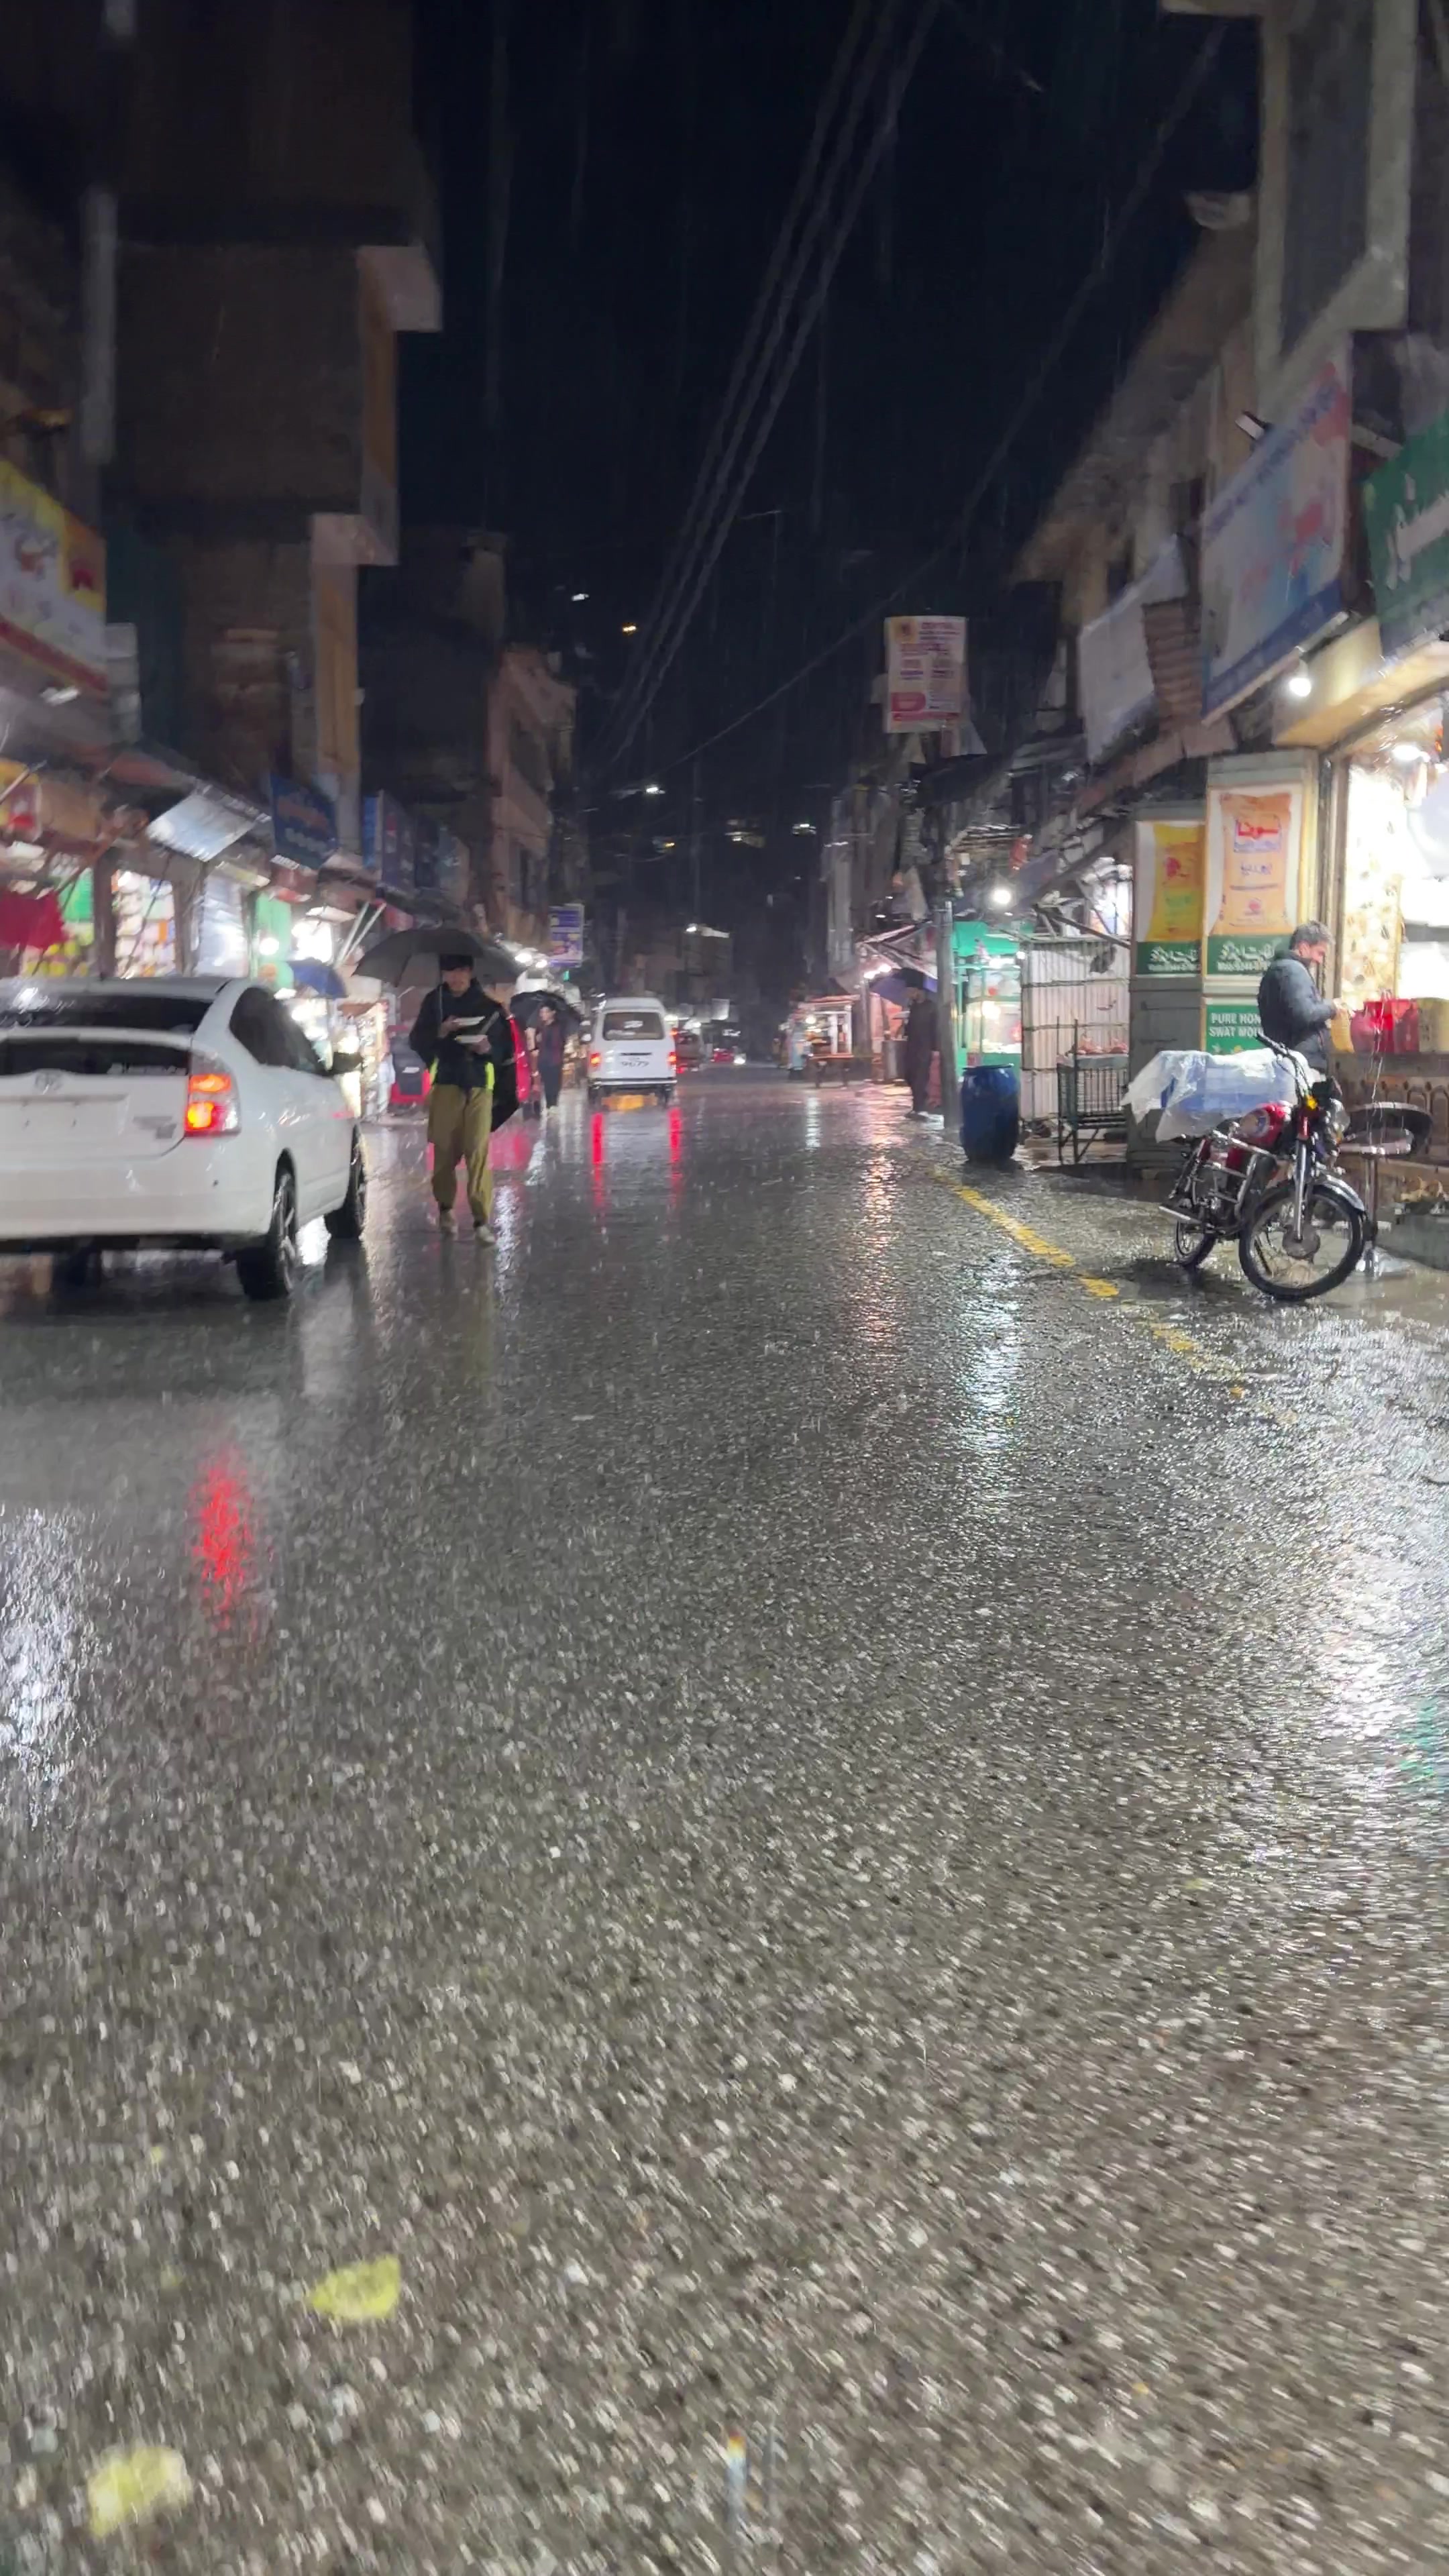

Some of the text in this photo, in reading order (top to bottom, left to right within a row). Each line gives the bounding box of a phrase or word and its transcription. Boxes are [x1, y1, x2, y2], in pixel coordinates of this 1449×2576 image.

[1212, 1013, 1262, 1024] PURE HON
[1210, 1026, 1236, 1037] SWAT
